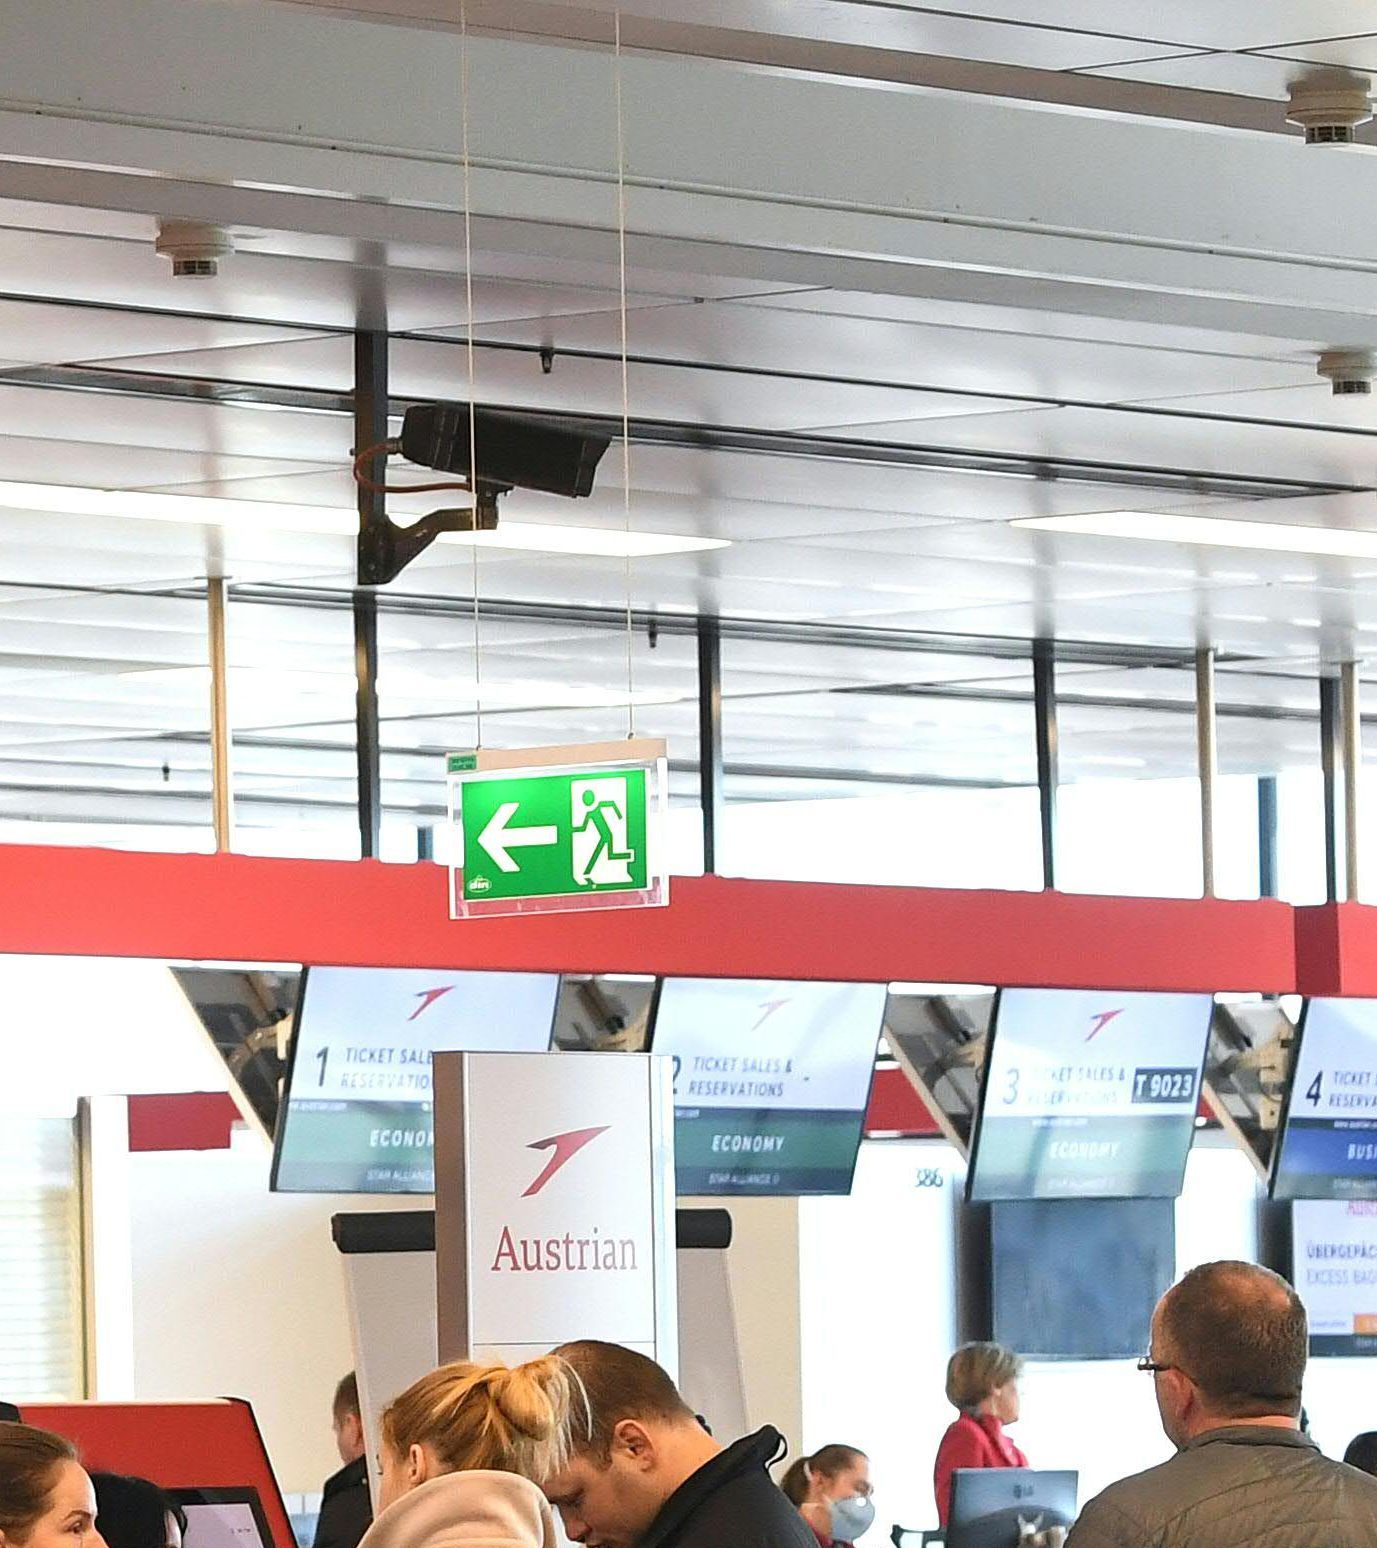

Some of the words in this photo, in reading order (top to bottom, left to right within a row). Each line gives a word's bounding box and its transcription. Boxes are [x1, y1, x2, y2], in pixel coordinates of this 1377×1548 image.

[345, 1048, 394, 1063] TICKET
[399, 1048, 432, 1065] SALE
[693, 1056, 736, 1072] TICKET
[742, 1058, 779, 1073] SALES
[316, 1046, 329, 1088] 1
[340, 1073, 430, 1090] RESERVATIO
[1136, 1075, 1148, 1096] T
[1150, 1074, 1193, 1097] 9023
[1332, 1071, 1371, 1086] TICKET
[688, 1080, 784, 1097] RESERVATIONS
[1305, 1070, 1324, 1108] 4
[369, 1129, 433, 1149] ECONO
[711, 1134, 785, 1152] ECONOMY
[491, 1225, 639, 1272] Austrian
